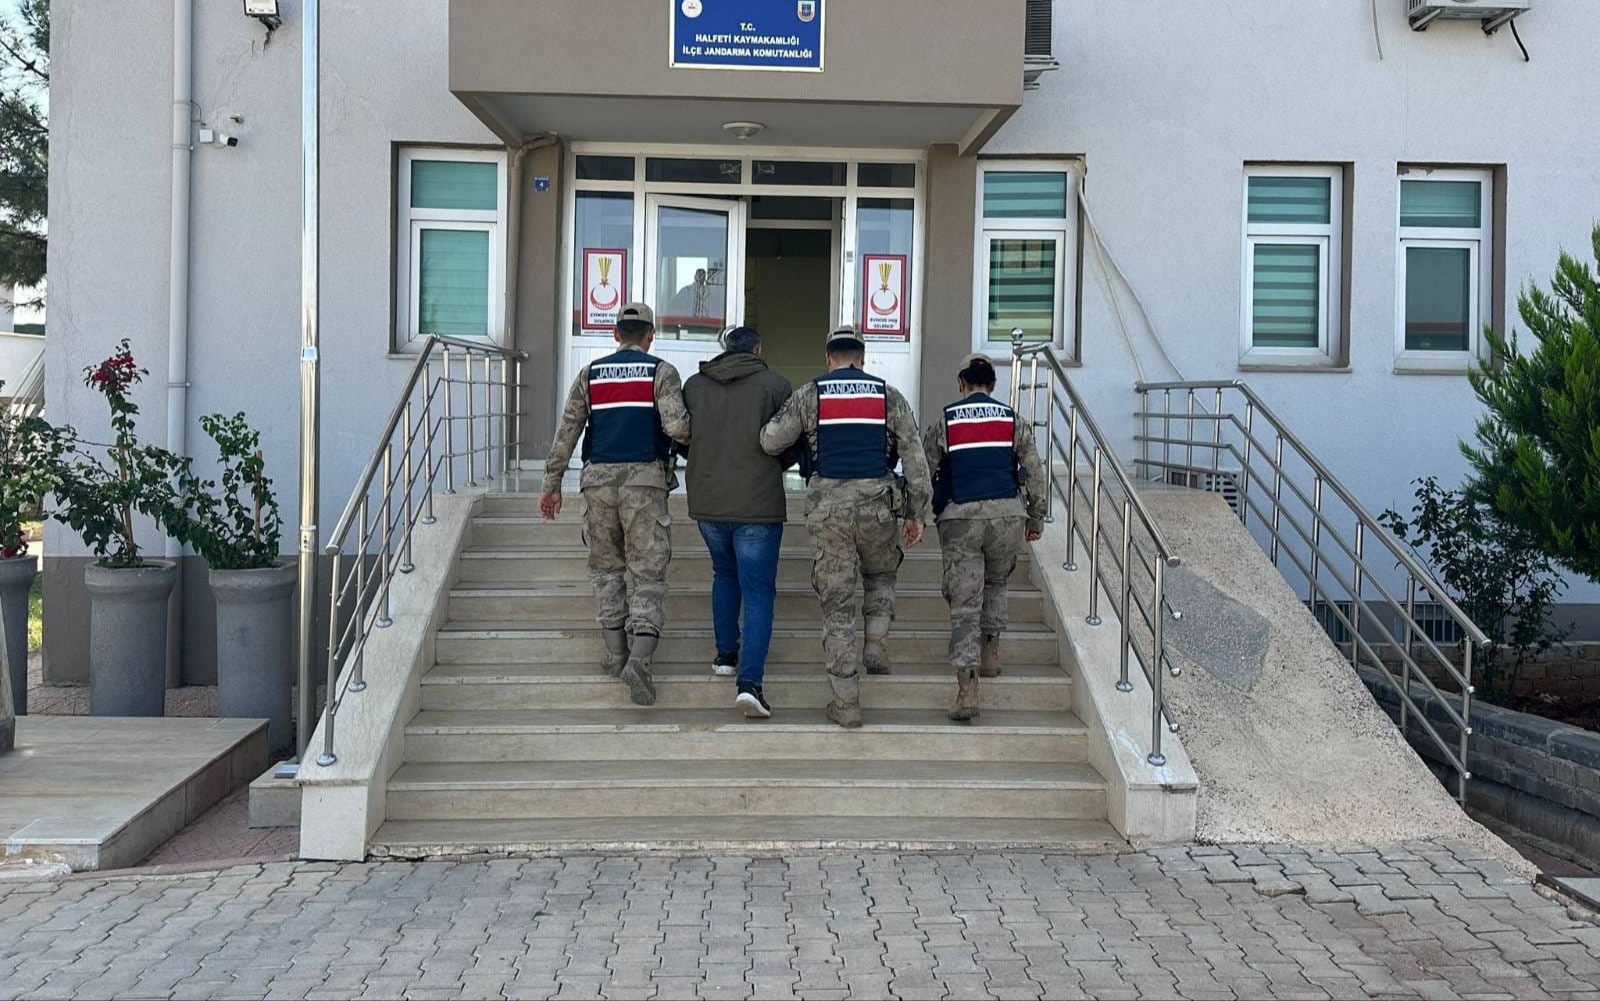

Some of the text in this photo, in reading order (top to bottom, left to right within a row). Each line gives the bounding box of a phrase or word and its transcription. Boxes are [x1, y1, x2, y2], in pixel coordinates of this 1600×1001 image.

[740, 23, 756, 31] T.C.
[695, 34, 800, 46] HALFETİ KAYMAKAMLIĞI
[682, 45, 812, 59] İLÇE JANDARMA KOMUTANLIĞI
[597, 366, 649, 380] JANDARMA
[823, 383, 879, 395] JANDARMA
[953, 407, 1007, 420] JANDARMA
